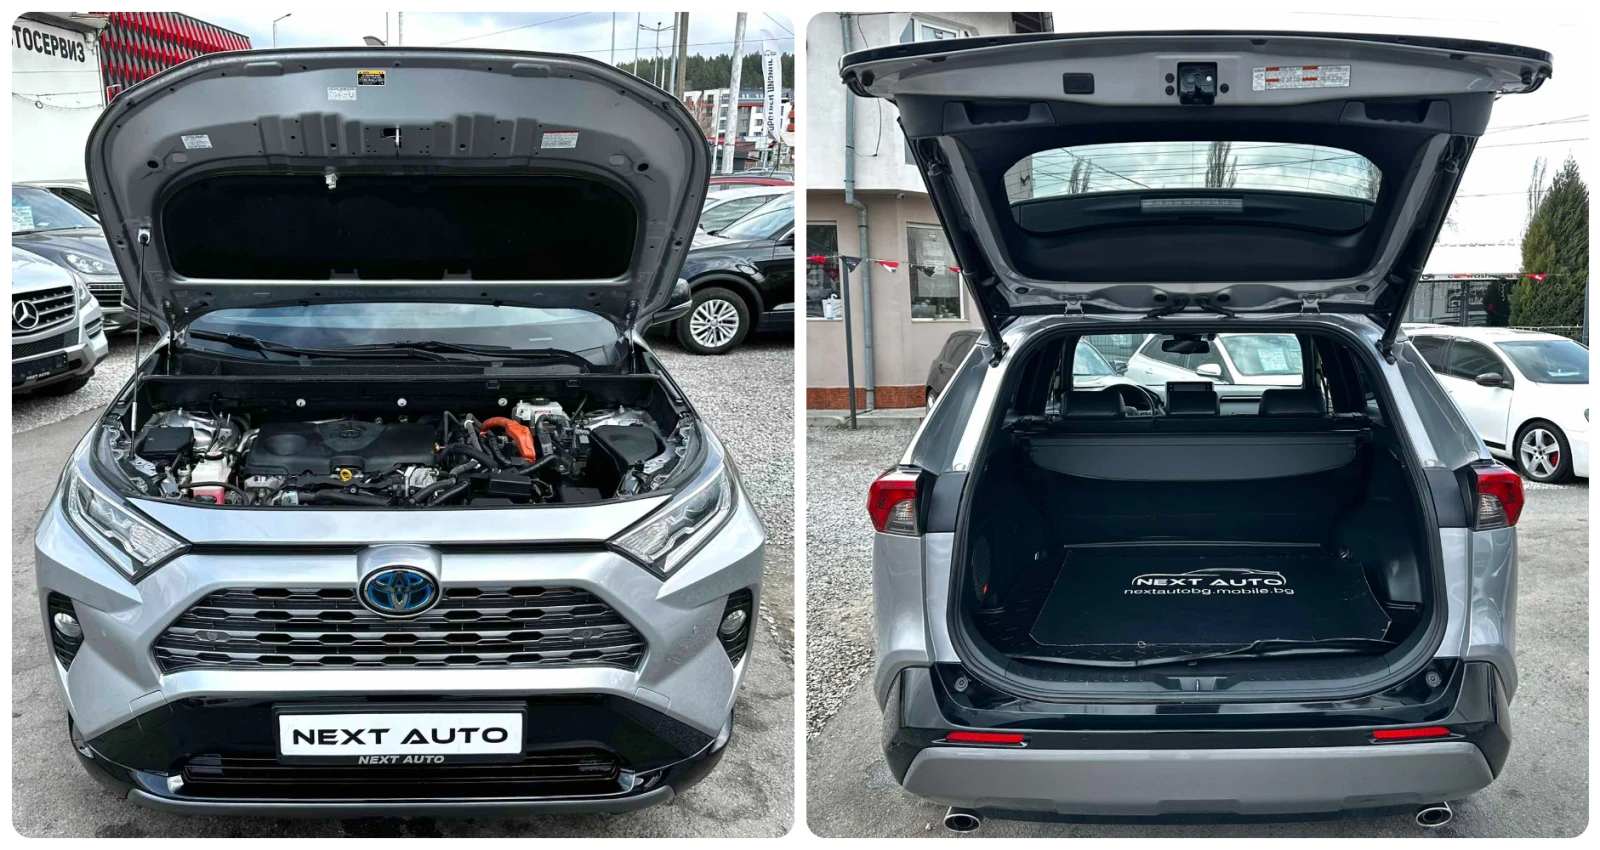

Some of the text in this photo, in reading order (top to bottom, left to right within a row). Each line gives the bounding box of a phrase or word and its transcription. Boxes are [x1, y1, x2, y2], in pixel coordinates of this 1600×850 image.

[12, 25, 85, 63] ТОСЕРВИЗ
[1136, 578, 1283, 586] NEXT AUTO
[1124, 587, 1295, 595] nextautobg.mobile.bg
[293, 727, 508, 745] NEXT AUTO
[358, 755, 445, 765] NEXT AUTO
